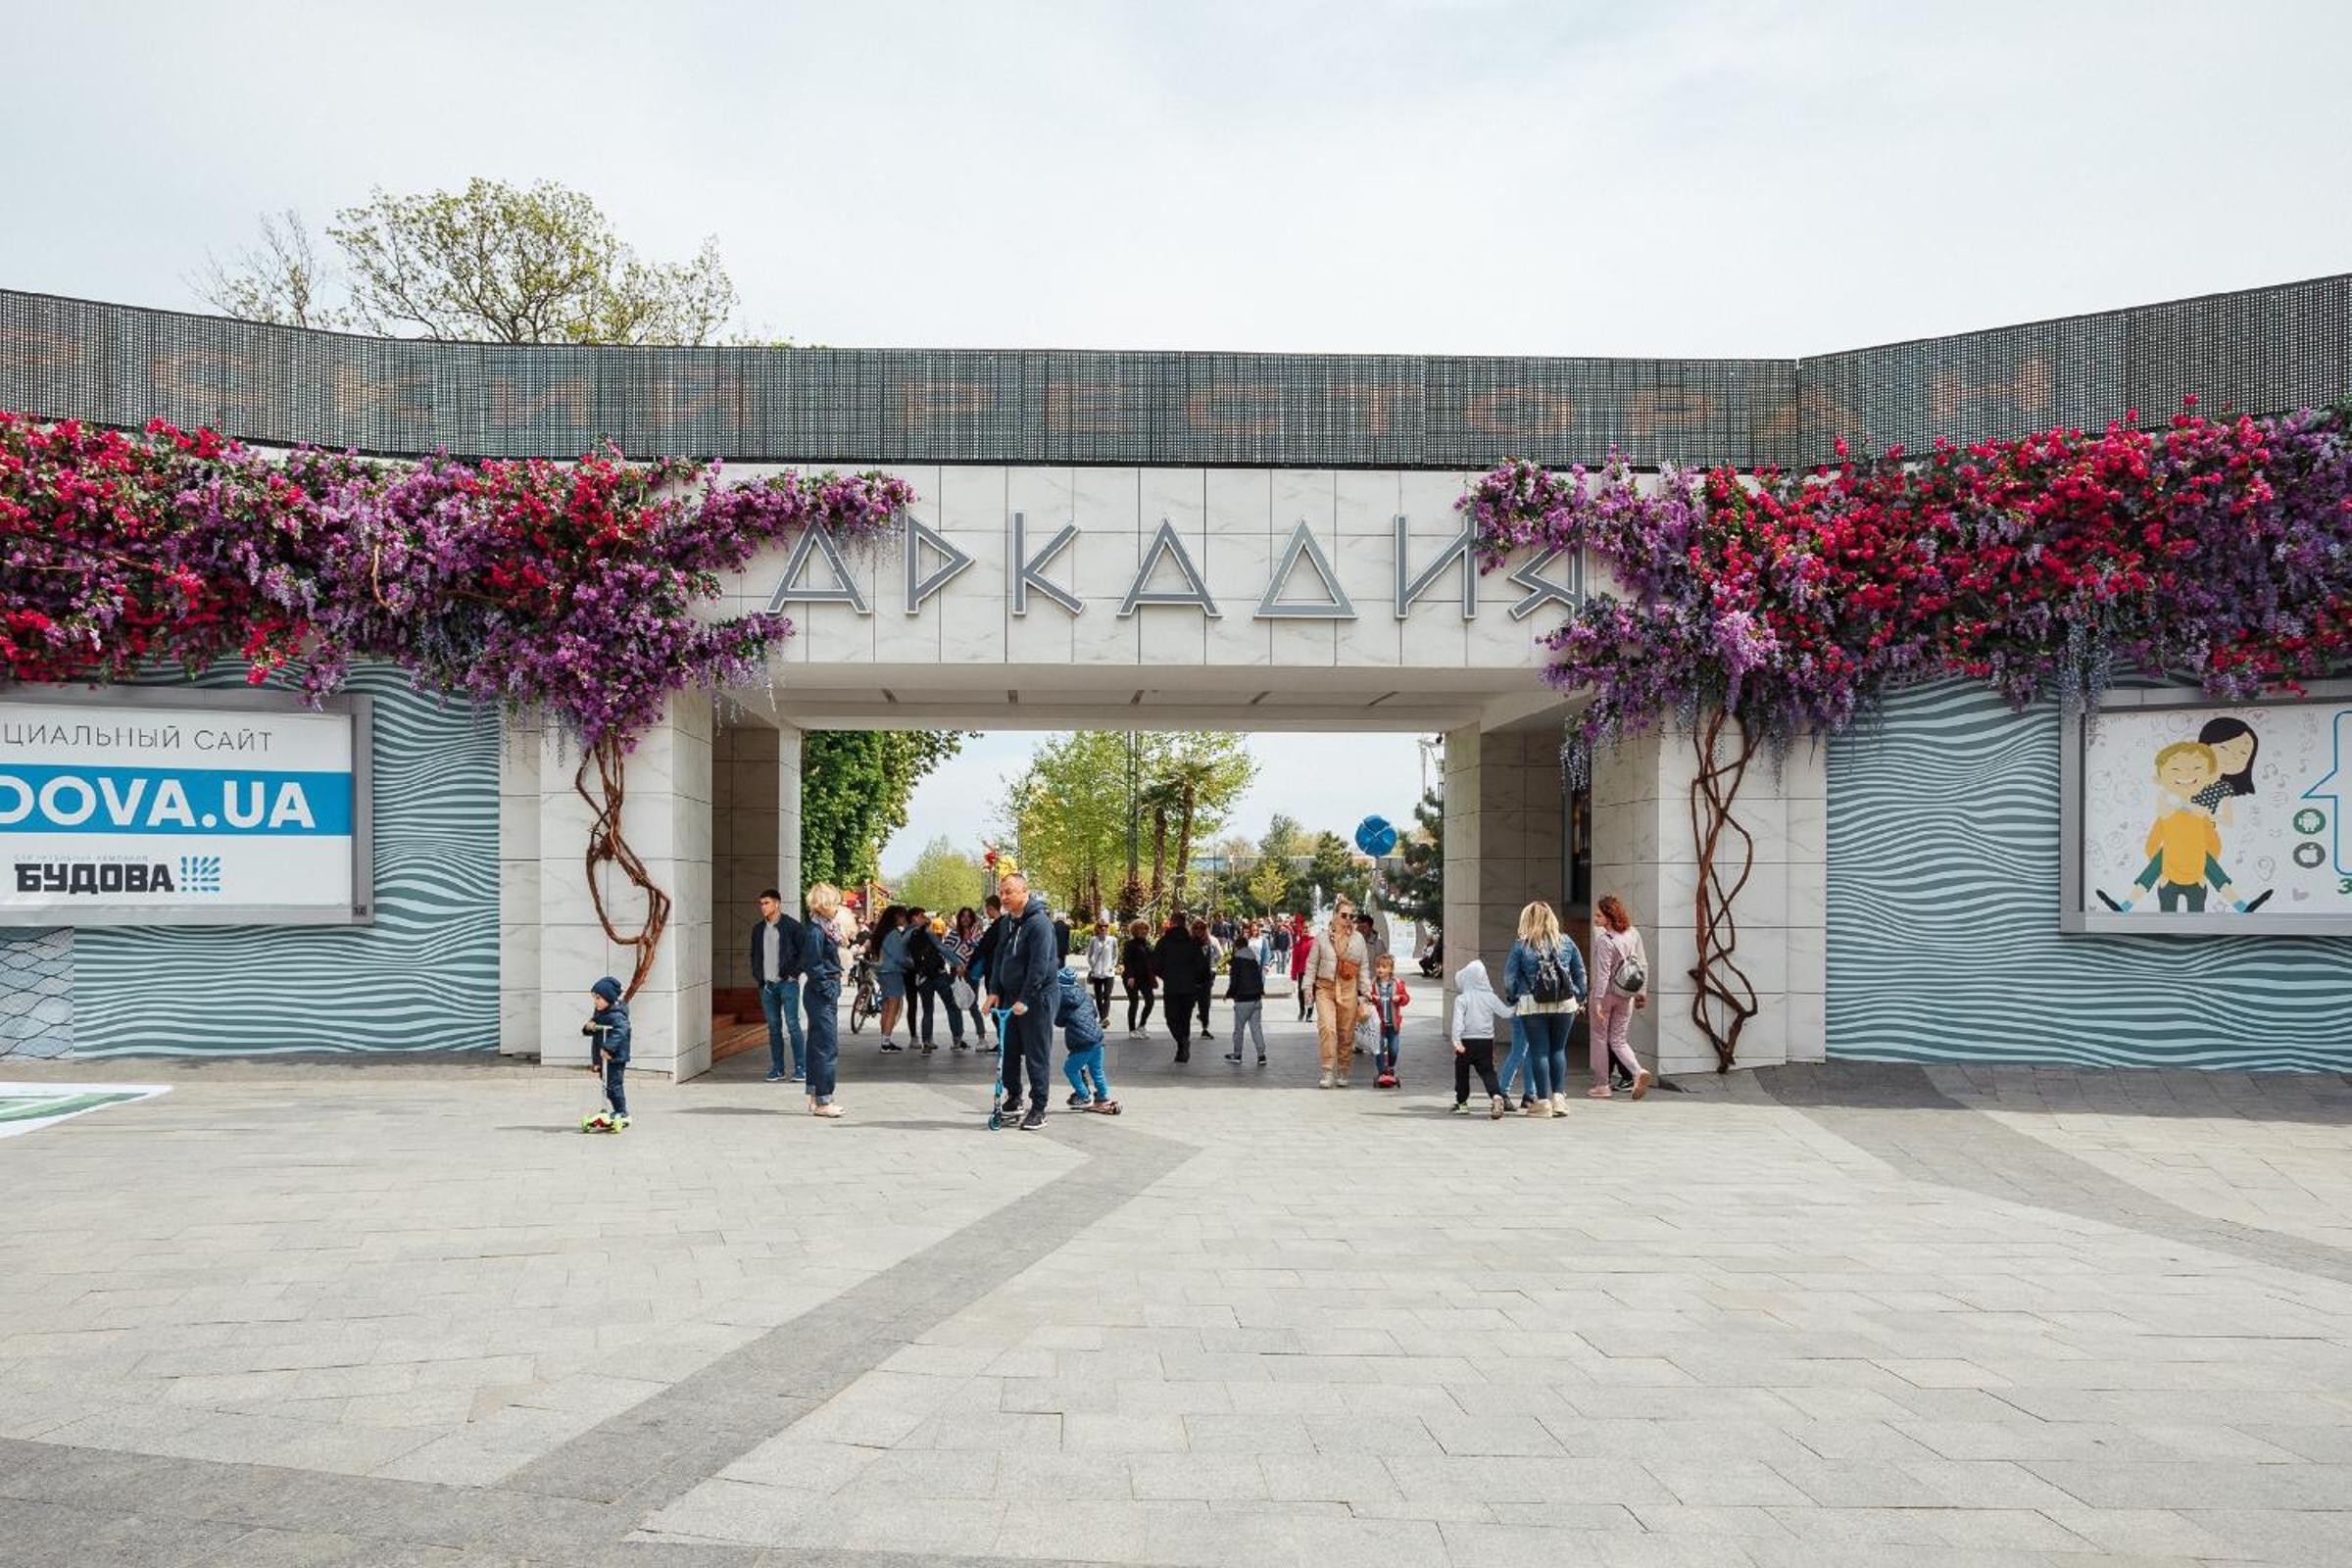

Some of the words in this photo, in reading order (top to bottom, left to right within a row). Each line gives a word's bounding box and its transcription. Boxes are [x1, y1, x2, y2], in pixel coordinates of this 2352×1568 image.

[764, 511, 1587, 621] АРКАДИЯ
[194, 728, 272, 753] САЙТ
[14, 863, 174, 894] БУДОВА
